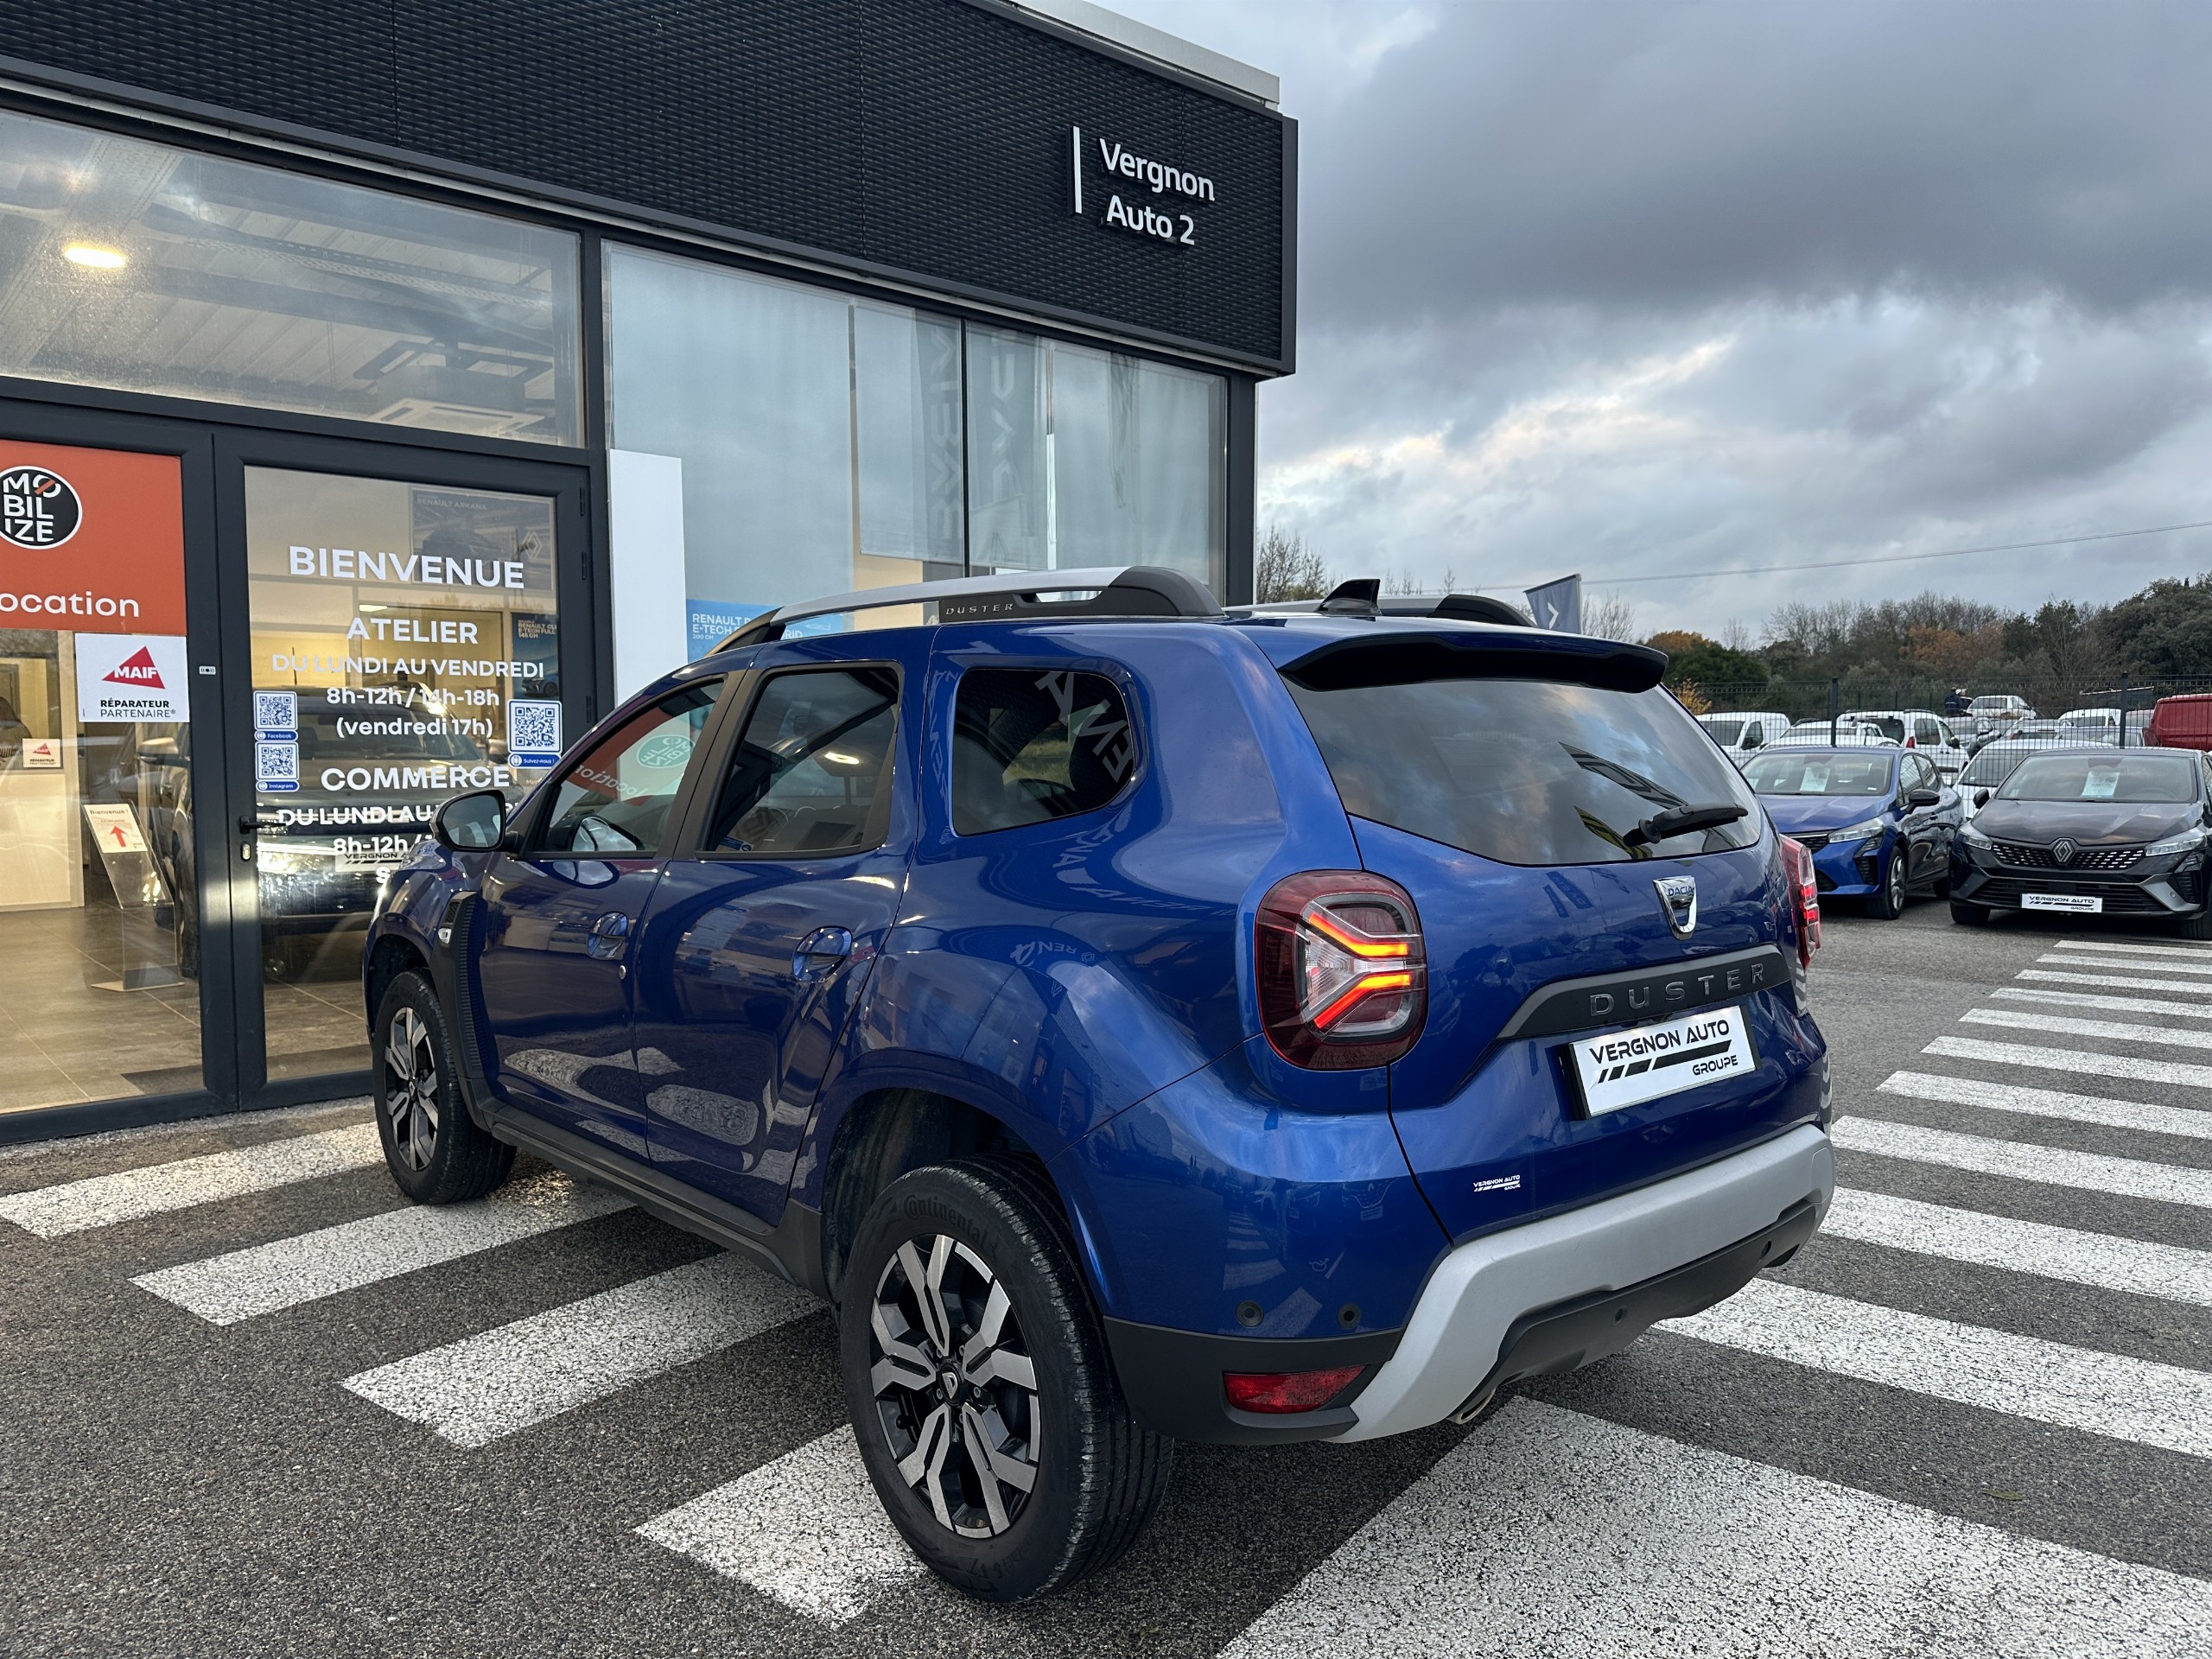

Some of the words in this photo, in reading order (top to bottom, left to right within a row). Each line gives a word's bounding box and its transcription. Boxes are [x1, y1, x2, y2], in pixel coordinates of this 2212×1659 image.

[1099, 138, 1215, 201] Vergnon
[1106, 194, 1173, 238] Auto
[1179, 215, 1195, 245] 2
[3, 494, 54, 519] BIL
[417, 498, 453, 508] RENAULT
[454, 501, 487, 511] ARKANA
[4, 518, 54, 543] IZE
[289, 544, 524, 589] BIENVENUE
[0, 591, 139, 617] ocation
[945, 603, 1014, 615] DUSTER
[692, 613, 741, 626] RENAULT
[692, 624, 732, 635] E-TECH
[346, 617, 479, 645] ATELIER
[114, 666, 158, 679] MAIF
[272, 654, 308, 671] DU
[315, 656, 387, 675] LUNDI
[392, 658, 426, 676] AU
[431, 659, 544, 678] VENDREDI
[100, 696, 169, 709] RÉPARATEUR
[327, 688, 402, 705] 8h-12h
[422, 689, 499, 707] 14h-18h
[336, 717, 447, 738] (vendredi
[451, 718, 493, 738] 17h)
[321, 766, 510, 791] COMMERCE
[278, 809, 313, 826] DU
[320, 807, 391, 824] LUNDI
[397, 805, 432, 823] AU
[333, 835, 408, 855] 8h-12h
[345, 851, 397, 860] VERGNON
[1667, 886, 1694, 896] DACIA
[1589, 962, 1764, 1018] DUSTER
[1589, 1028, 1681, 1065] VERGNON
[1685, 1019, 1730, 1045] AUTO
[1692, 1053, 1738, 1077] GROUPE
[1473, 1178, 1503, 1187] VERGNON
[904, 1195, 988, 1250] Continental
